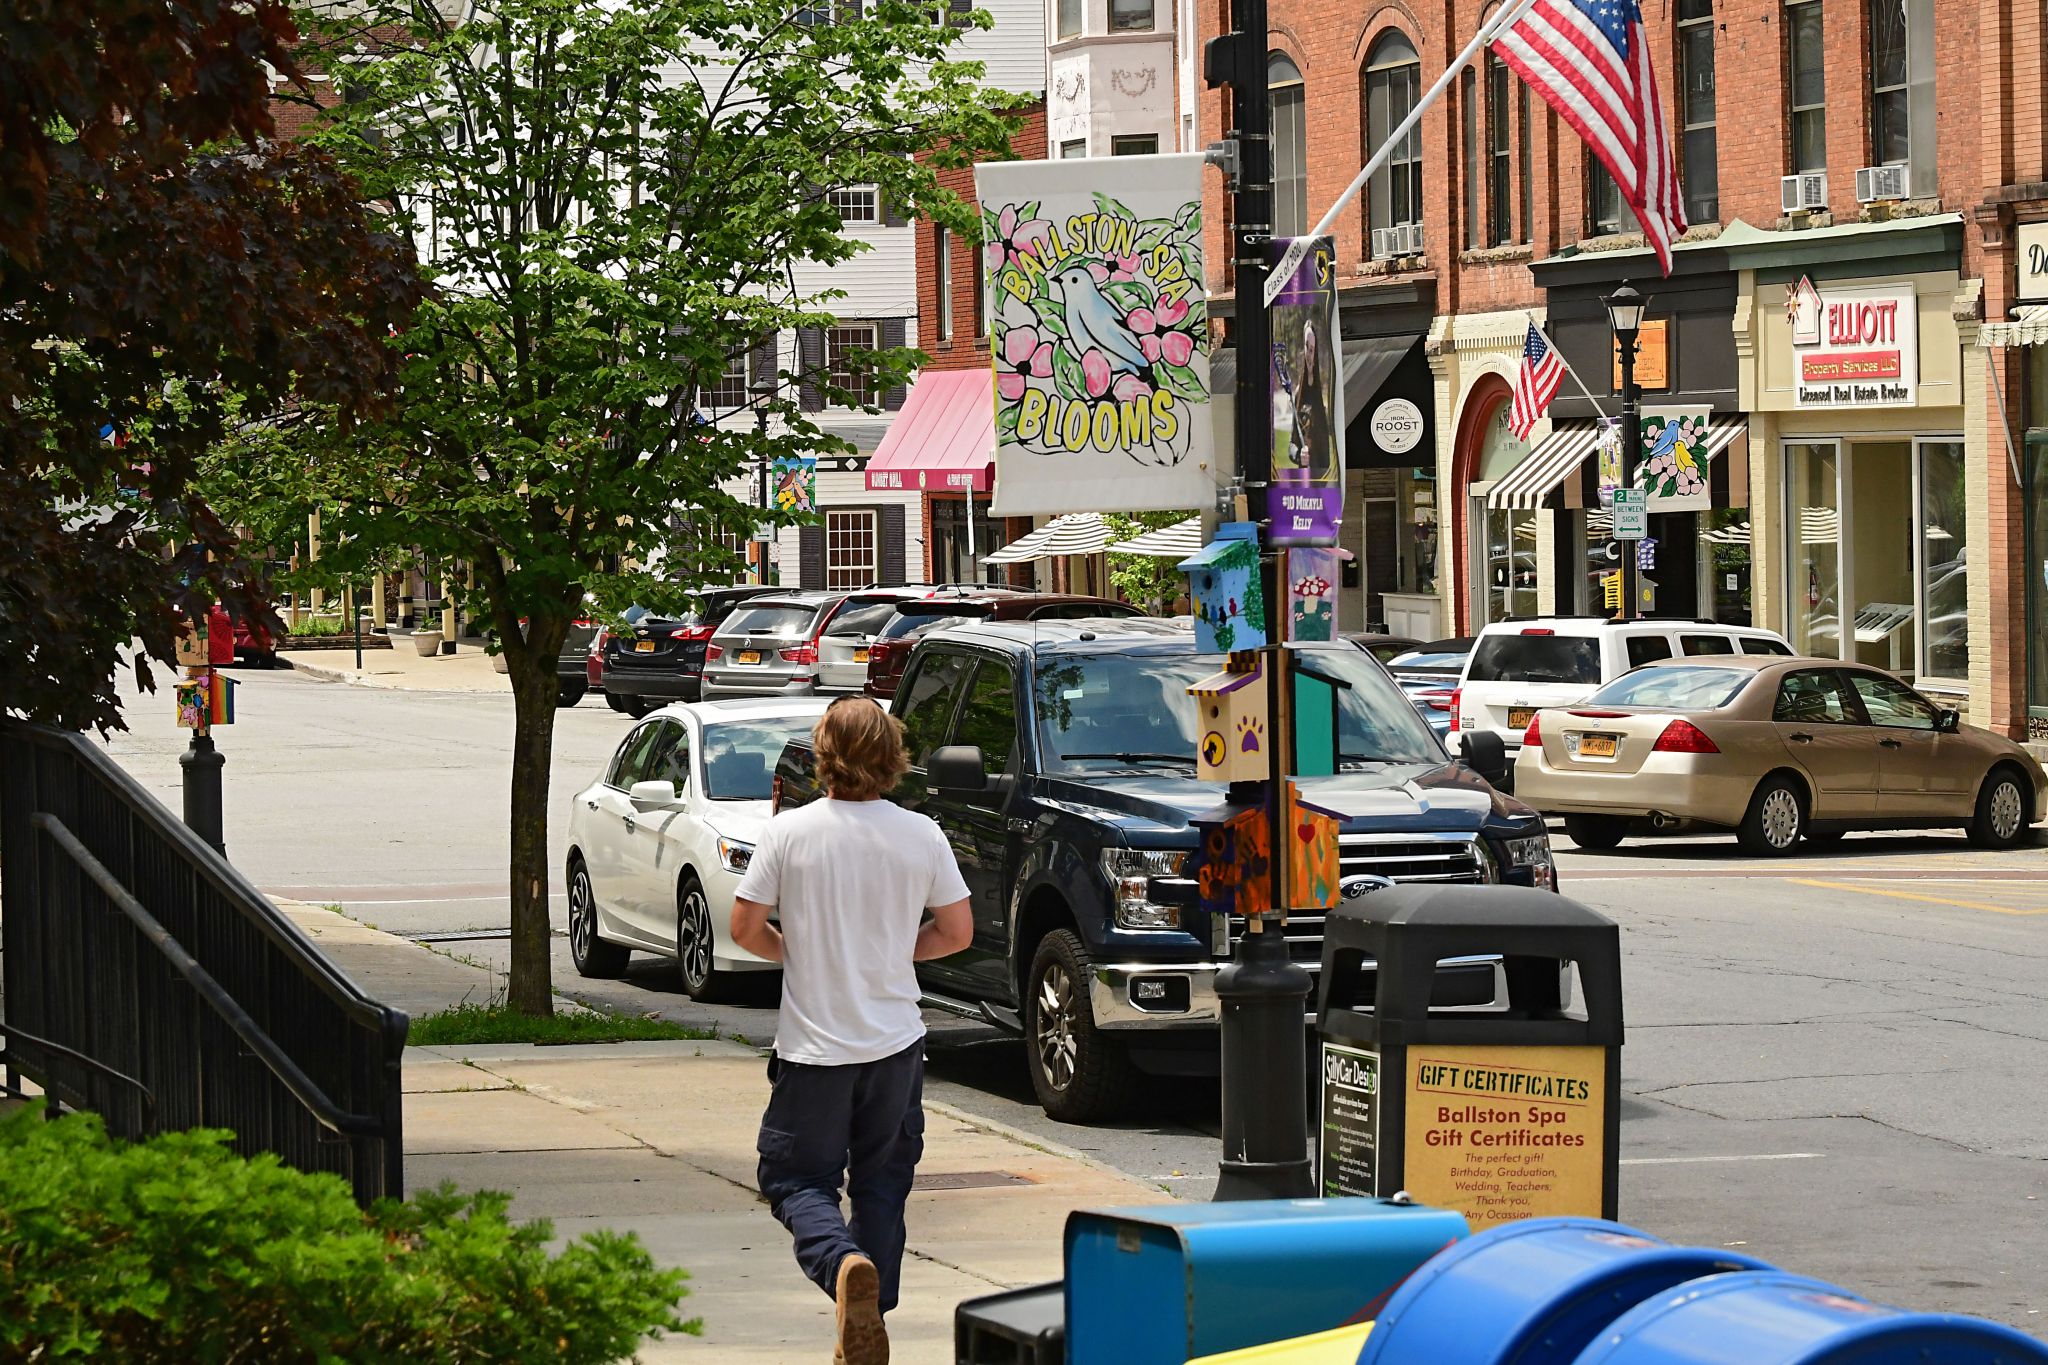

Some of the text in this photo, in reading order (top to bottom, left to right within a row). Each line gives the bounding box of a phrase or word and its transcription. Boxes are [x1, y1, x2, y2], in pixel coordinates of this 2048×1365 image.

[1001, 213, 1194, 309] BALLSTON SPA
[1267, 241, 1302, 296] Class of 2020
[1828, 300, 1898, 345] ELLIOTT
[1803, 356, 1897, 377] Property Services LLC
[1799, 382, 1908, 402] Licensed Real Estate Broker
[1016, 388, 1179, 454] BLOOMS
[1376, 421, 1420, 431] ROOST
[1617, 491, 1624, 501] 2
[1617, 505, 1644, 513] BETWEEN
[1622, 515, 1639, 523] SIGNS
[1353, 1061, 1377, 1094] Design
[1420, 1064, 1589, 1100] GIFT CERTIFICATES
[1437, 1106, 1566, 1127] Ballston Spa
[1425, 1129, 1585, 1147] Gift Certificates
[1465, 1153, 1544, 1165] The perfect gift!
[1450, 1167, 1557, 1179] Birthday, Graduation,
[1455, 1181, 1552, 1194] Wedding, Teachers,
[1475, 1195, 1531, 1208] Thank you,
[1464, 1210, 1533, 1221] Any Ocassion
